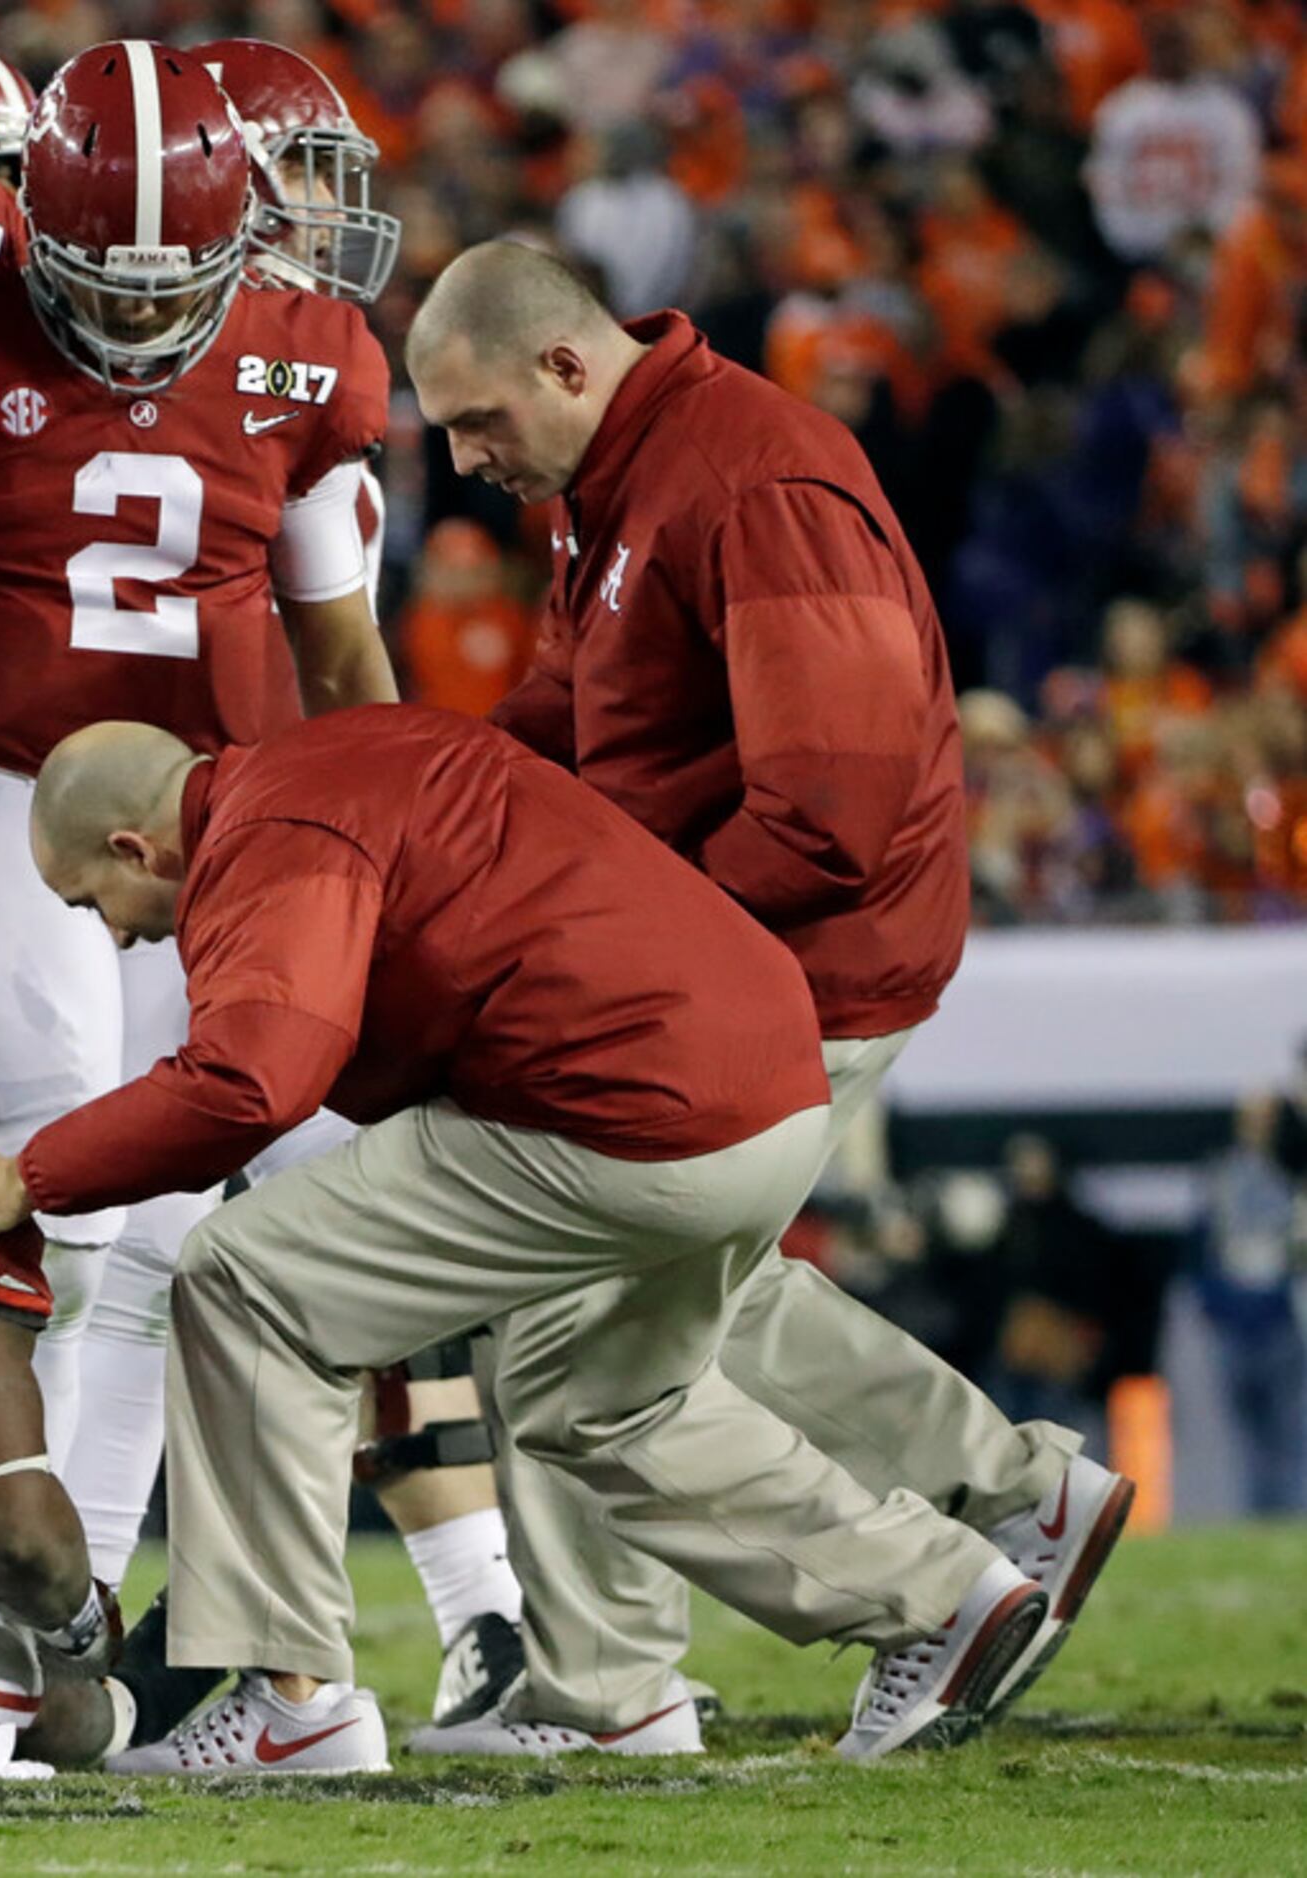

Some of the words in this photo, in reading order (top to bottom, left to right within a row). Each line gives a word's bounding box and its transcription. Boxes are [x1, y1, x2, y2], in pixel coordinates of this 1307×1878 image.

[237, 354, 339, 405] 2017
[0, 387, 48, 436] SEC
[65, 450, 205, 660] 2
